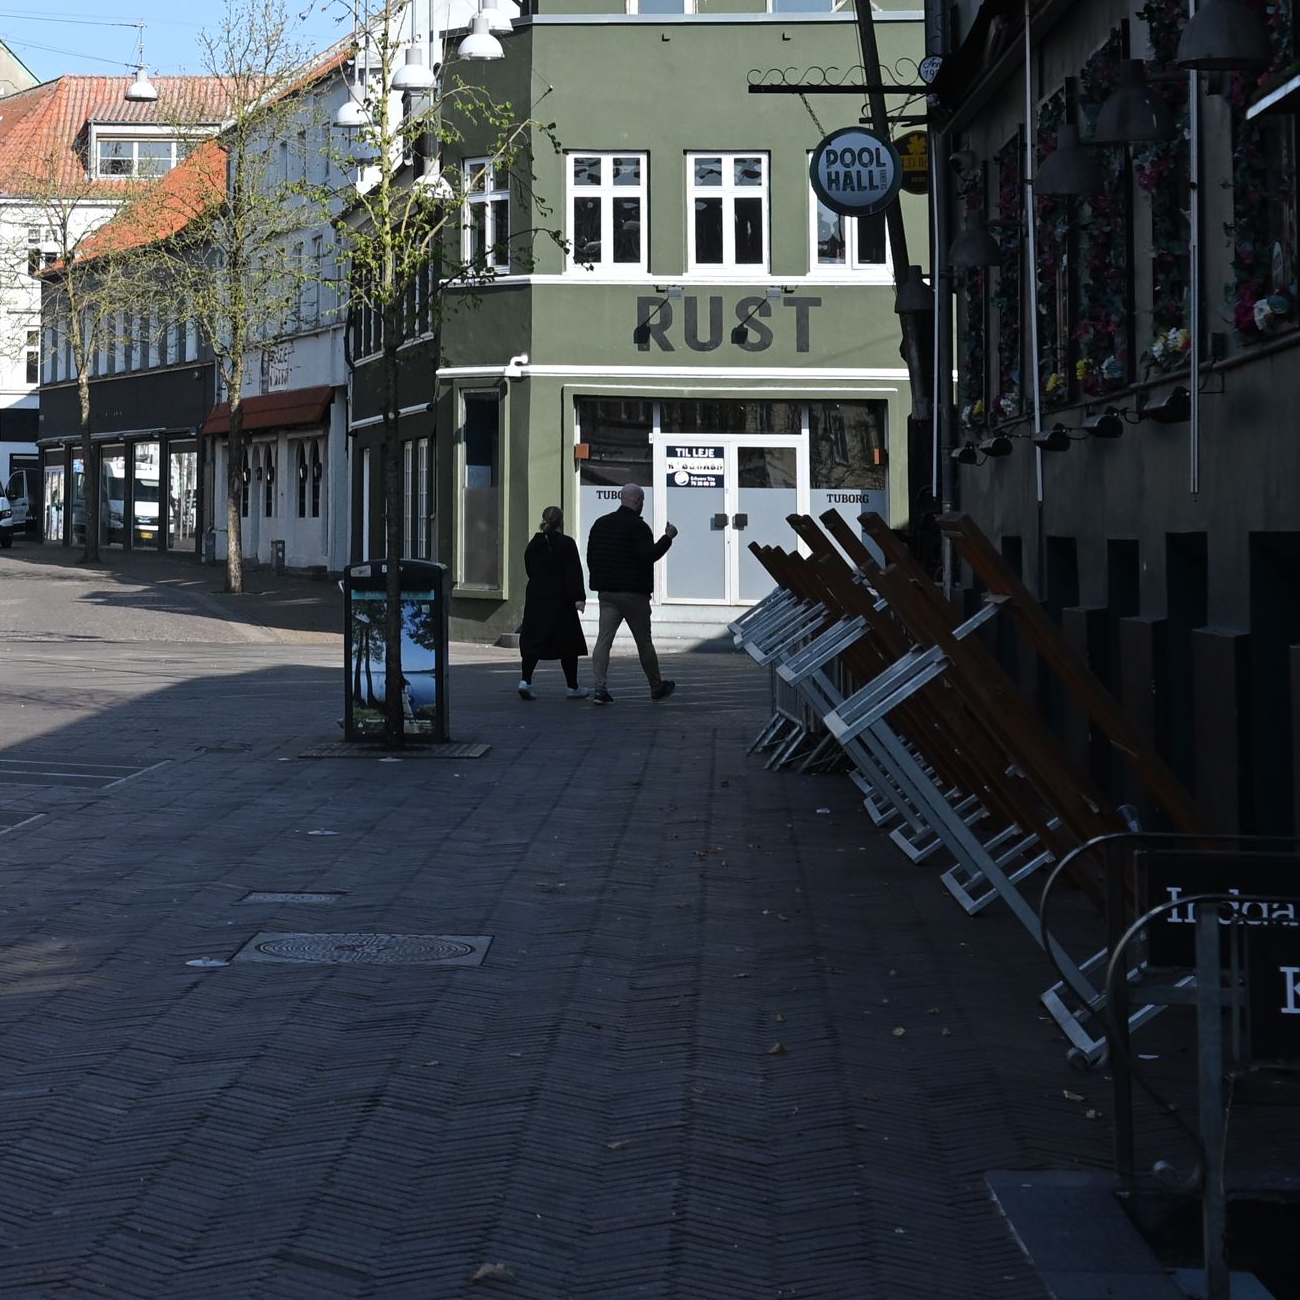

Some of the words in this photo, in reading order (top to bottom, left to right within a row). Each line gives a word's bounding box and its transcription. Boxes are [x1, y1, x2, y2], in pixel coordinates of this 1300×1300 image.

[825, 147, 886, 169] POOL
[827, 170, 879, 191] HALL
[636, 295, 822, 352] RUST
[675, 448, 691, 457] TIL
[693, 448, 715, 458] LEJE
[826, 493, 869, 504] TUBORG
